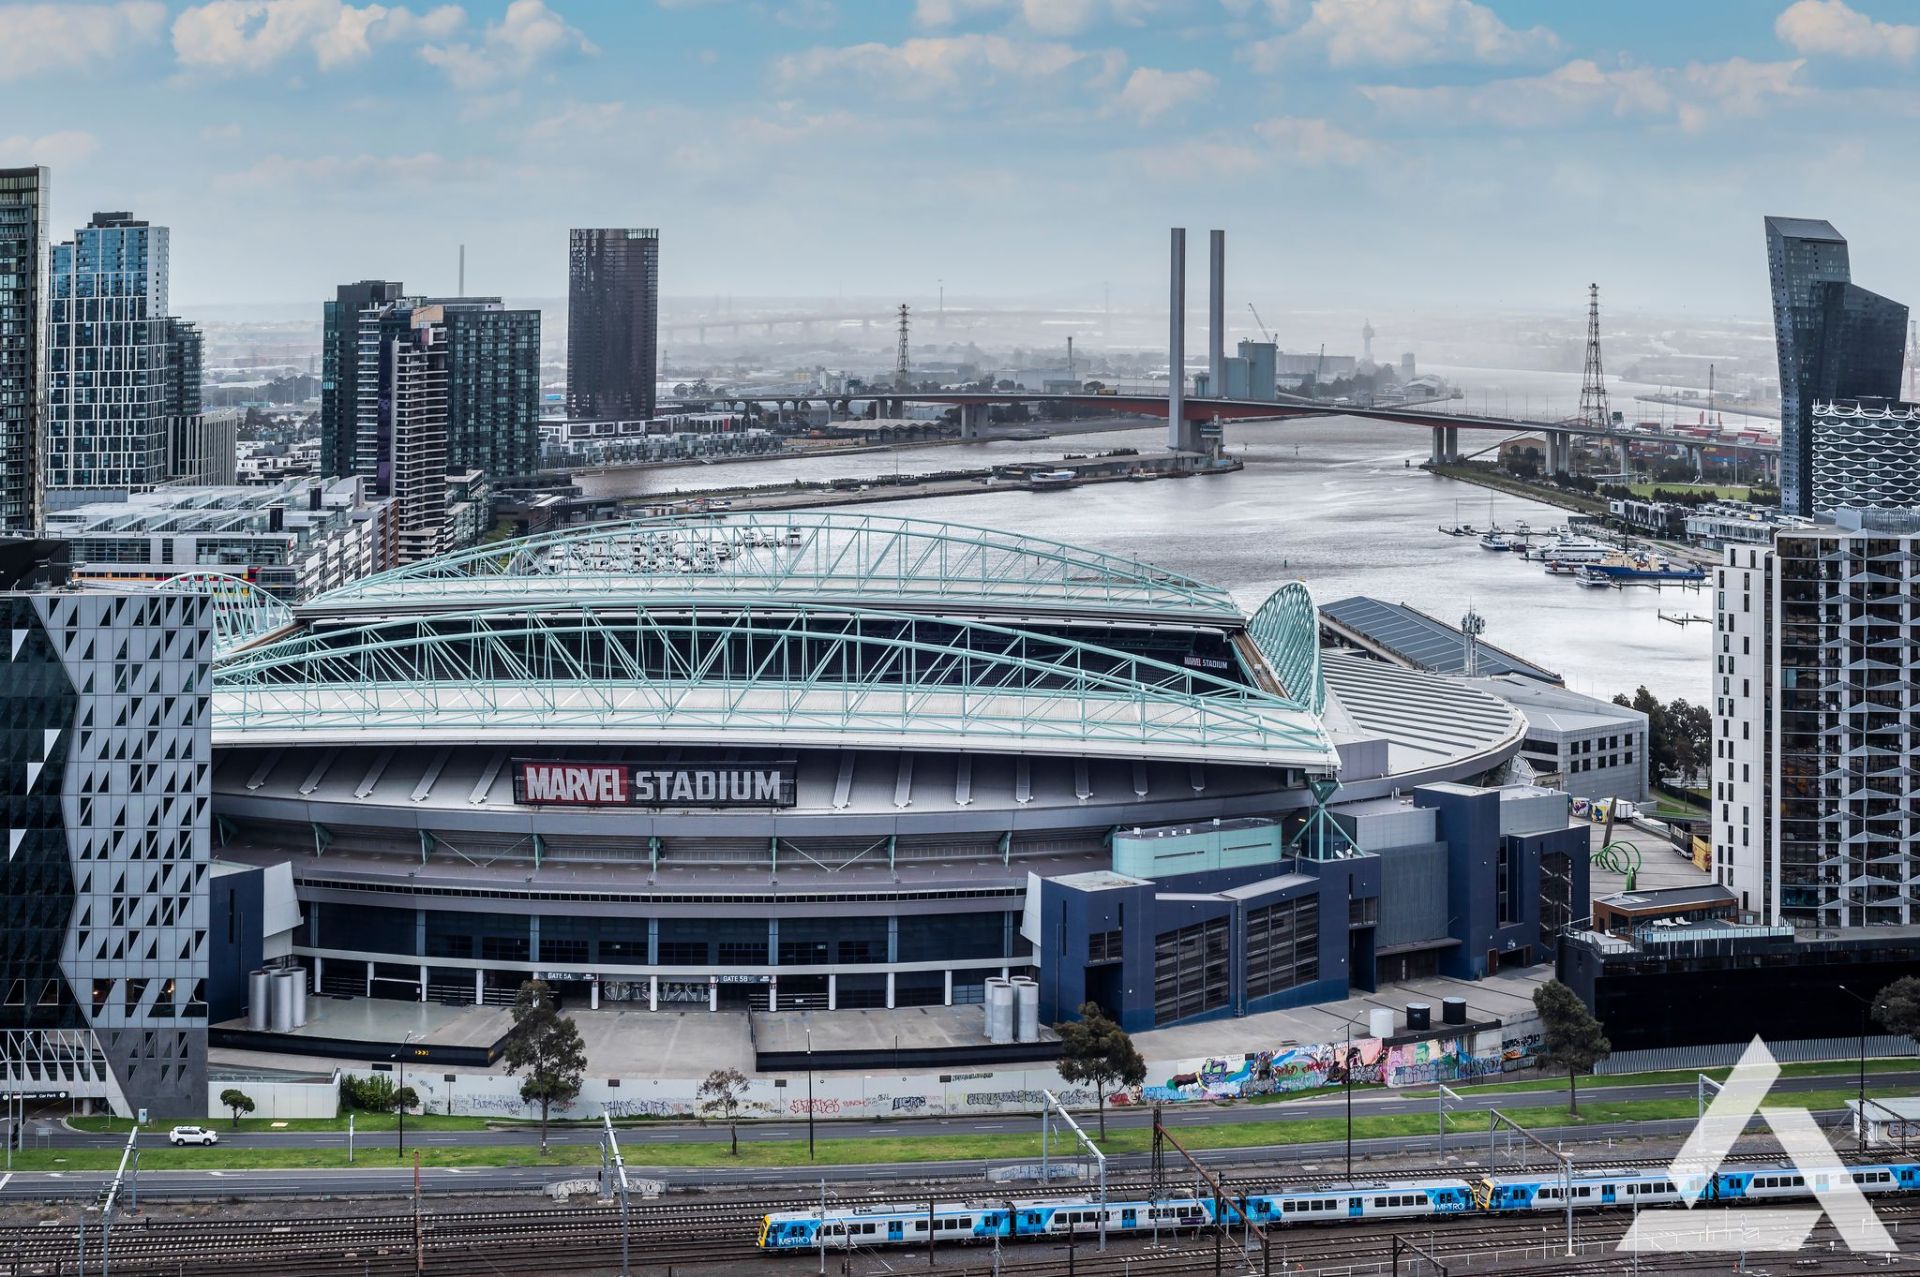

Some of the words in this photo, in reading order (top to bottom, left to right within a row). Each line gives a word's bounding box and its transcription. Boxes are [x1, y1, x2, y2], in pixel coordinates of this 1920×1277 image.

[1202, 660, 1228, 669] STADIUM
[525, 767, 627, 802] MARVEL
[635, 770, 781, 801] STADIUM
[1436, 1203, 1465, 1211] METRO
